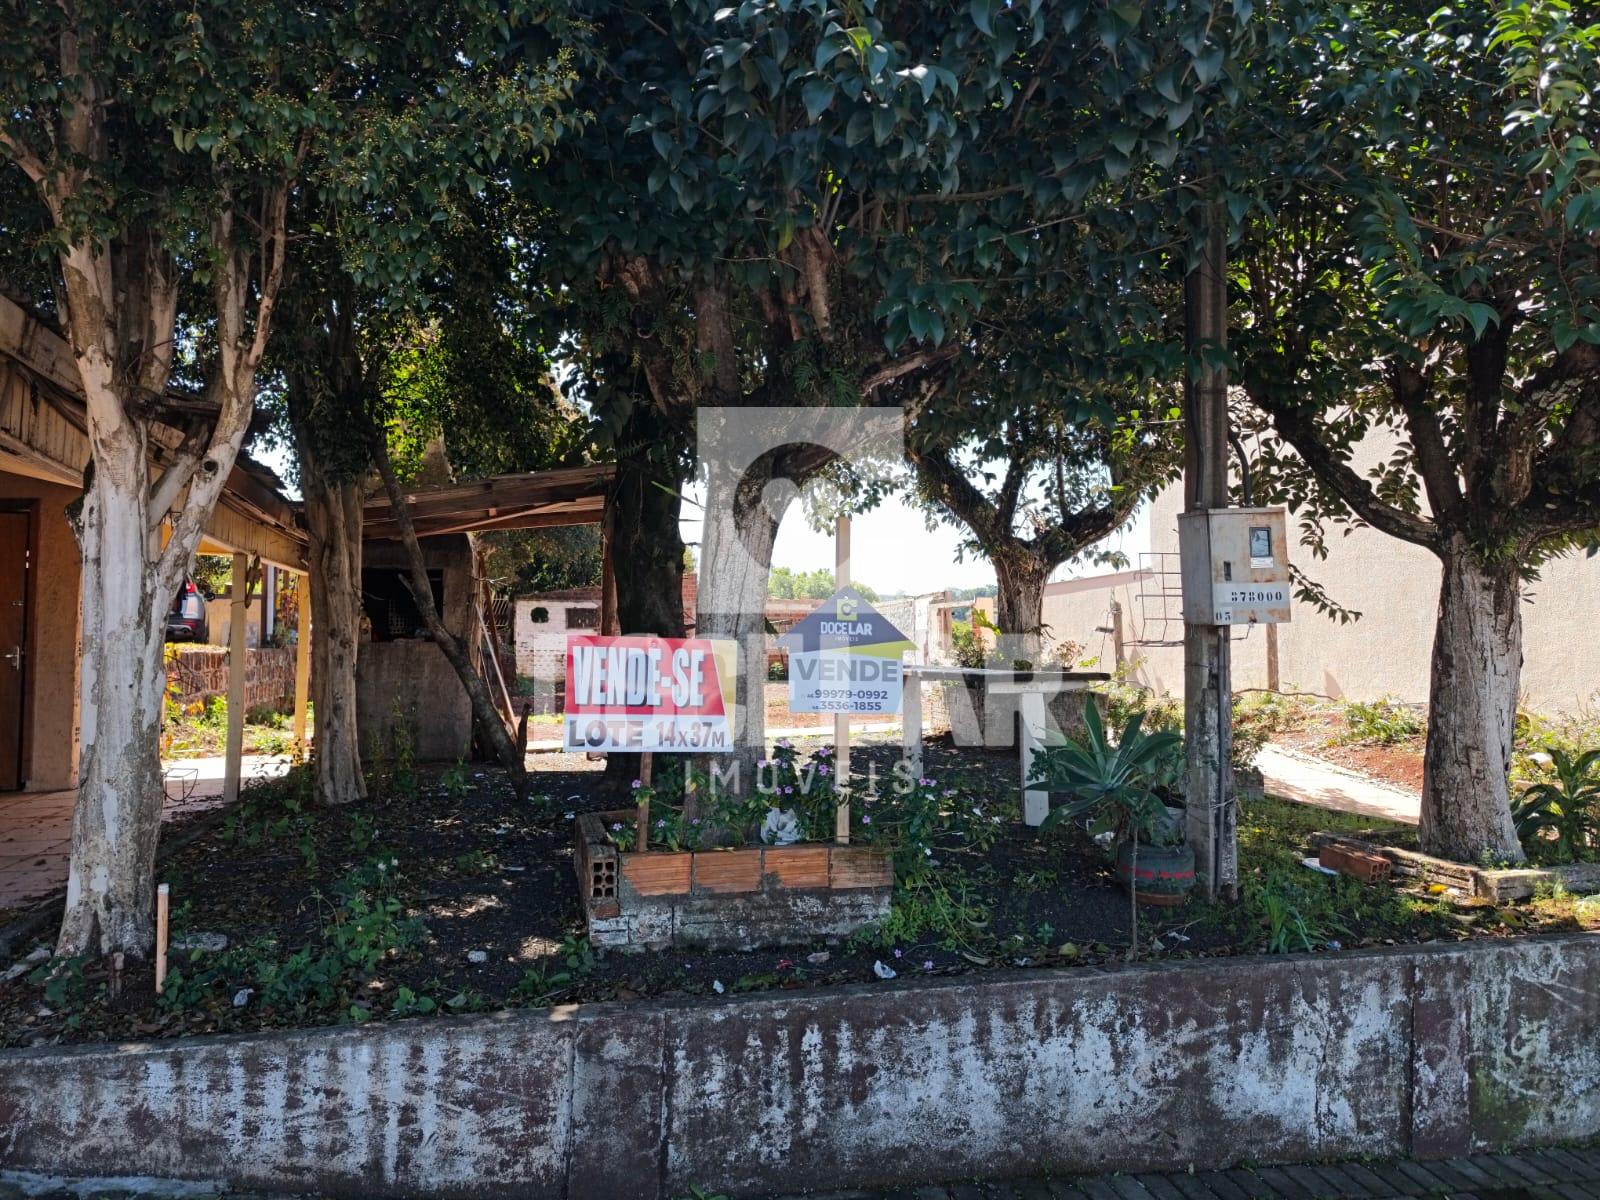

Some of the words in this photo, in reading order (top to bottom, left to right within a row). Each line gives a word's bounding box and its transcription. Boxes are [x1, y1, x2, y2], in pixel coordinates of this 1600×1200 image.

[1215, 611, 1232, 621] 05
[820, 621, 873, 636] DOCELAR
[572, 646, 705, 708] VENDE-SE
[795, 659, 898, 682] VENDE
[568, 720, 644, 748] LOTE
